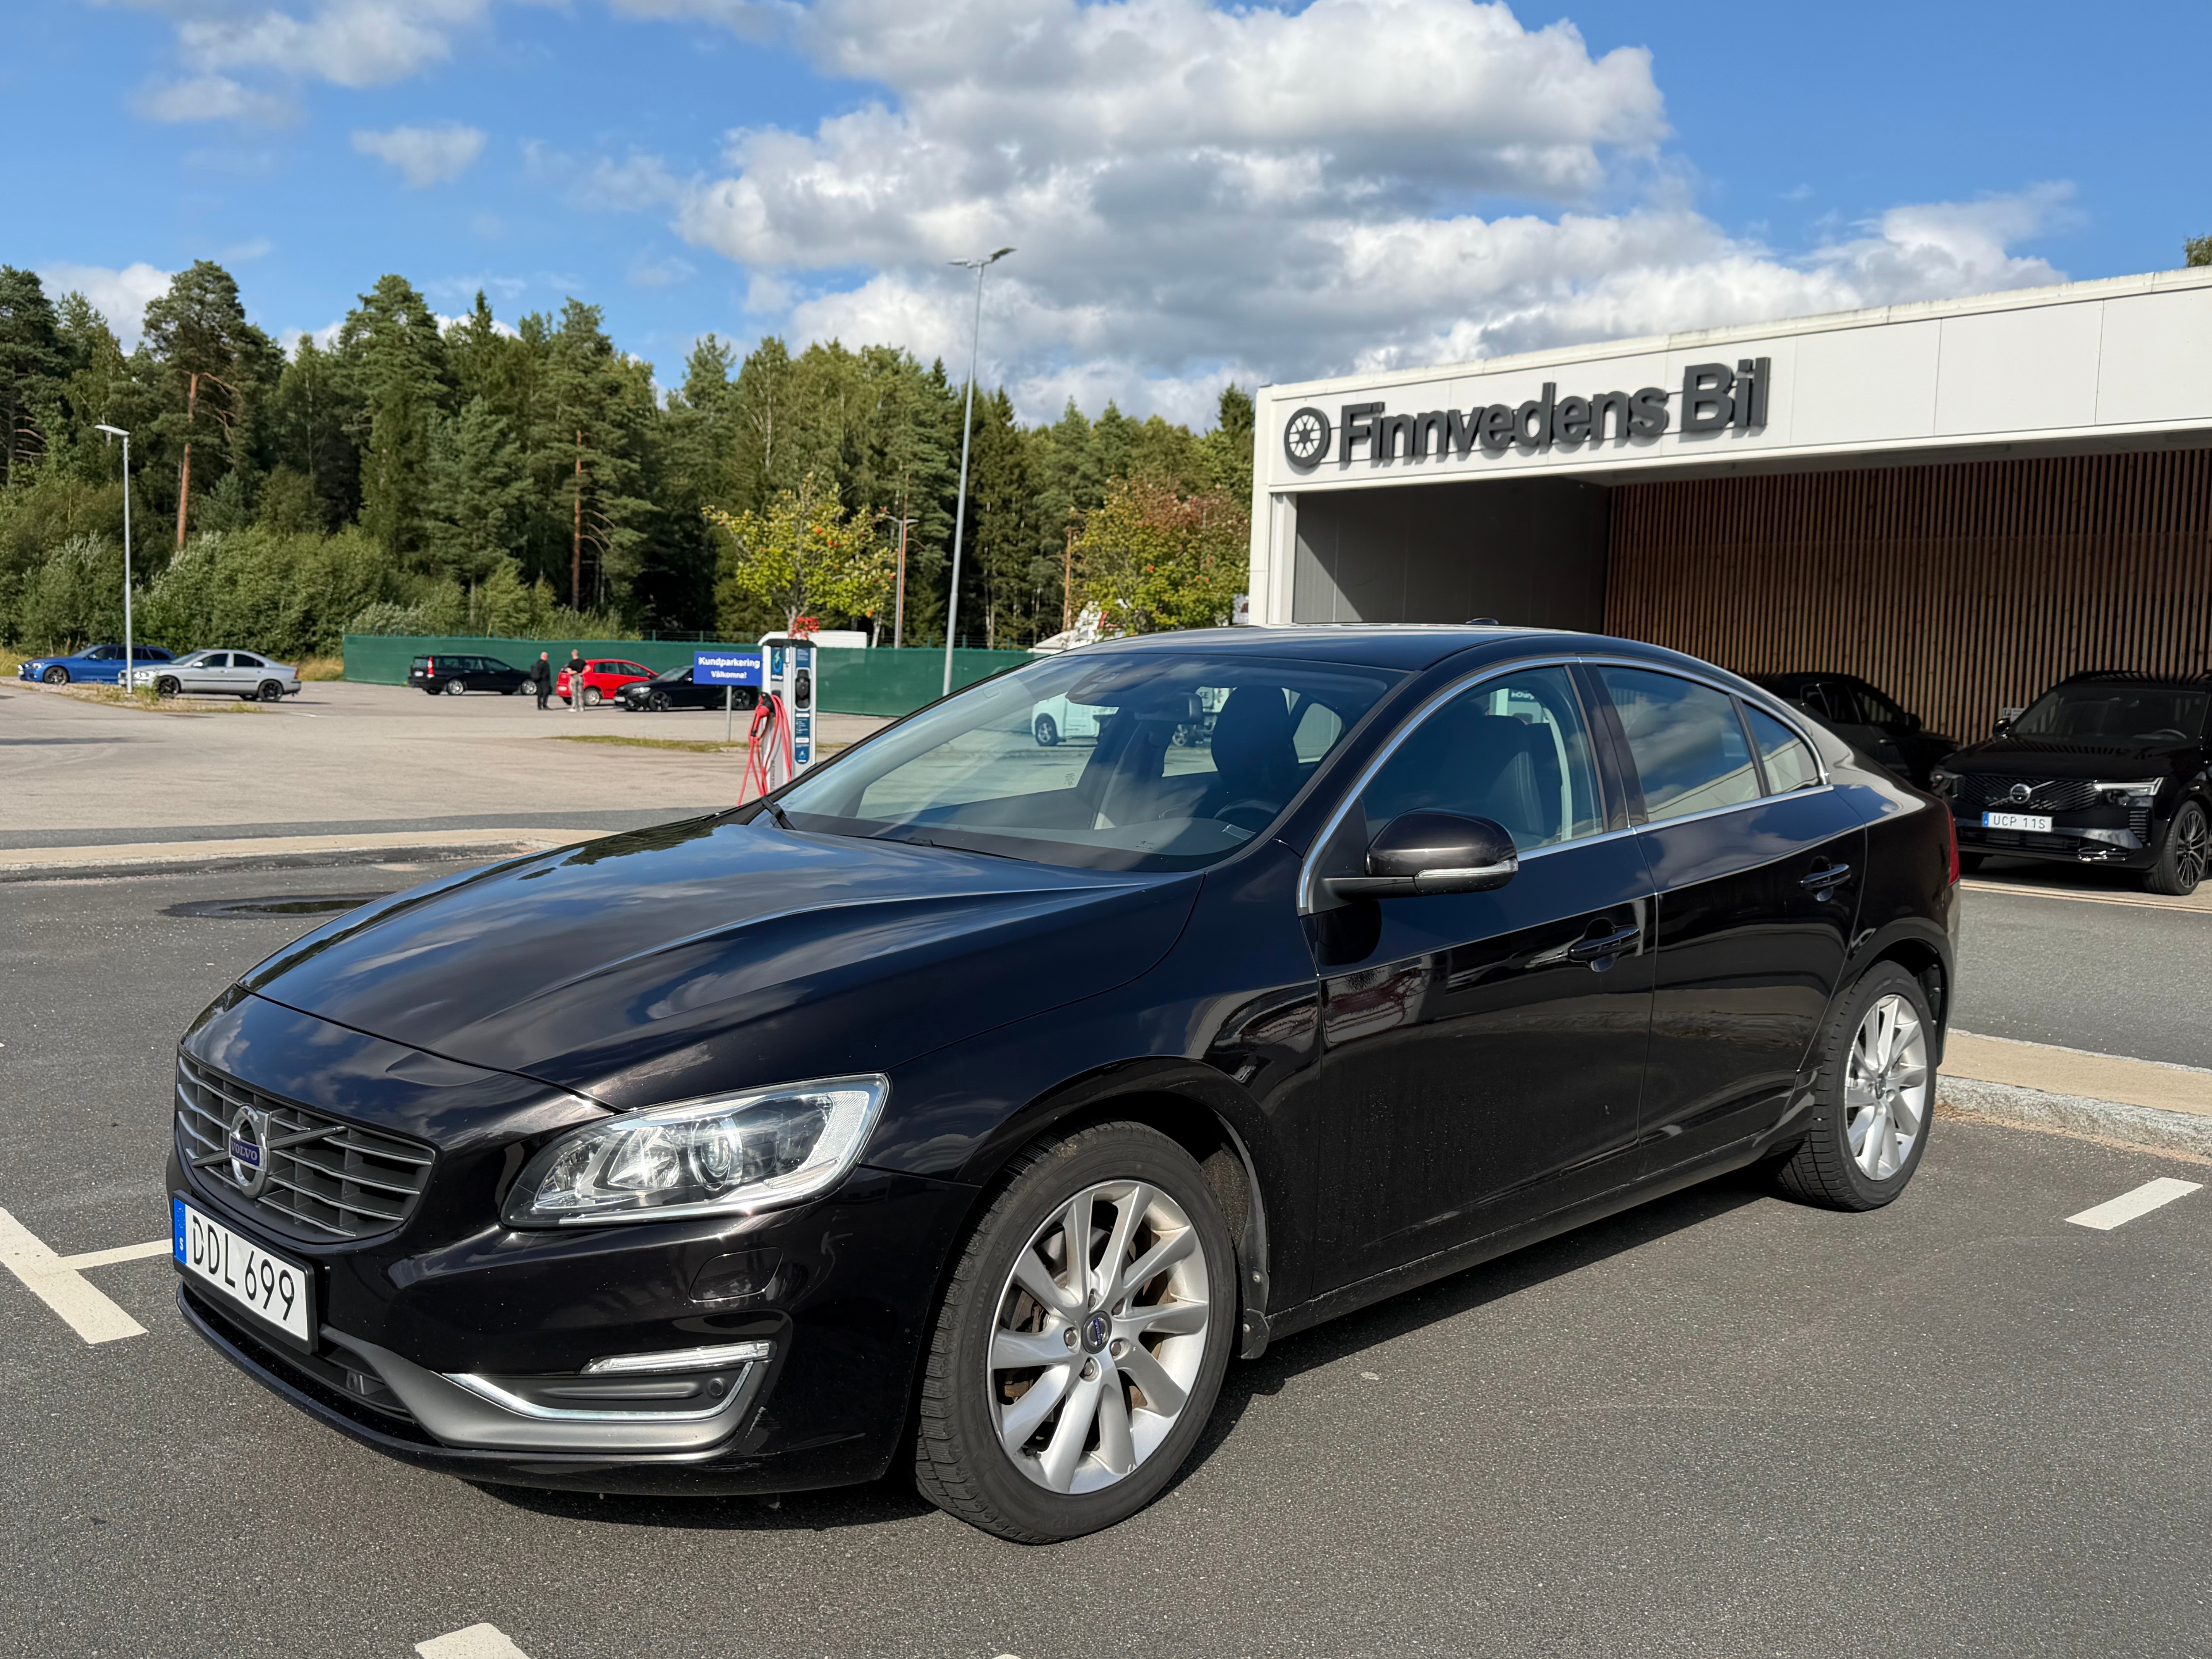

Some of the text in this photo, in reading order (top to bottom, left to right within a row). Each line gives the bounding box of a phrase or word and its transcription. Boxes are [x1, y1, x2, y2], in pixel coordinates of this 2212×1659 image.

[1340, 357, 1771, 462] Finnvedens Bil
[698, 657, 760, 669] Kundparkering
[1511, 691, 1535, 700] InCharg
[1994, 815, 2016, 826] UCP
[2023, 818, 2045, 829] 11S
[231, 1140, 258, 1160] VOLVO
[179, 1214, 294, 1321] S DDL 699
